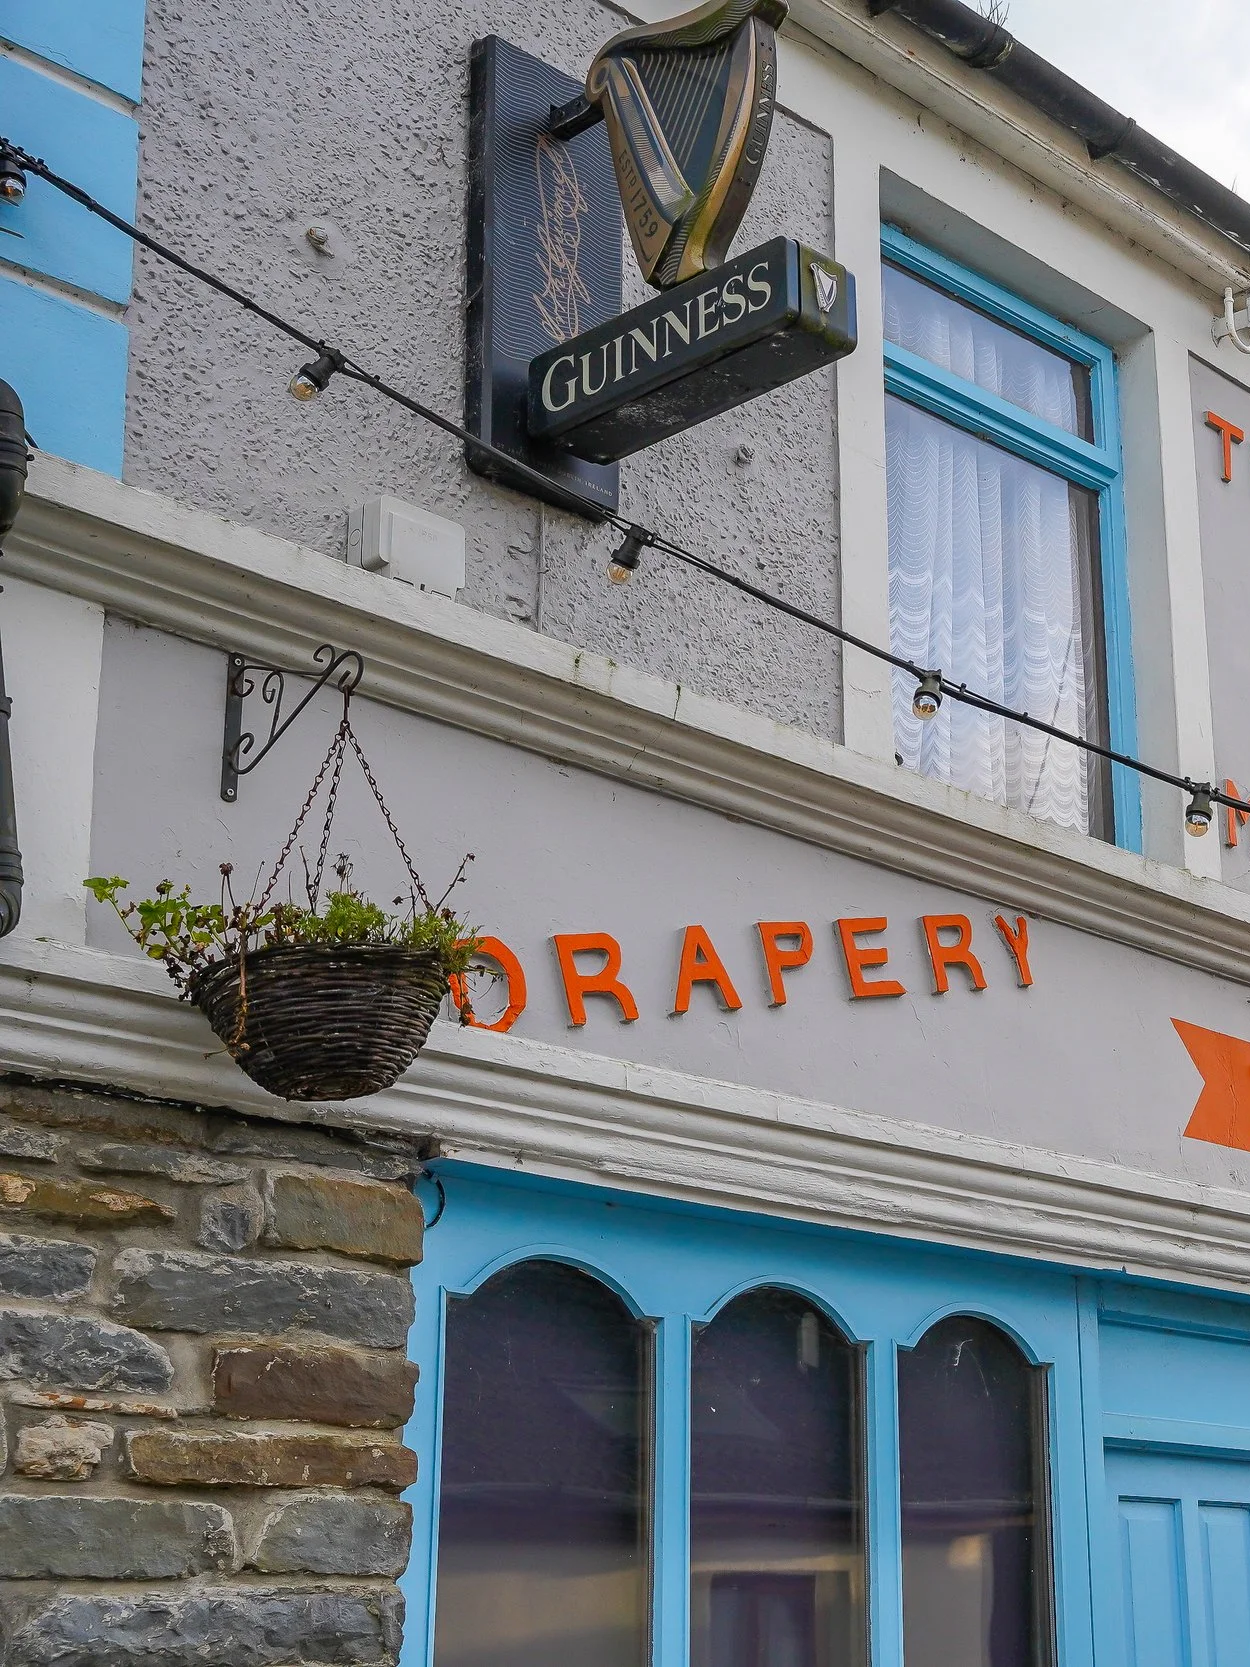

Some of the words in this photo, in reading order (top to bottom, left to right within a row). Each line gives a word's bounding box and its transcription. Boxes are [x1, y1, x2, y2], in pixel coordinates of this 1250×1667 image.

[746, 61, 774, 165] GUINNESS
[630, 187, 658, 238] 1759
[541, 261, 773, 413] GUINNESS
[449, 914, 1033, 1033] DRAPERY
